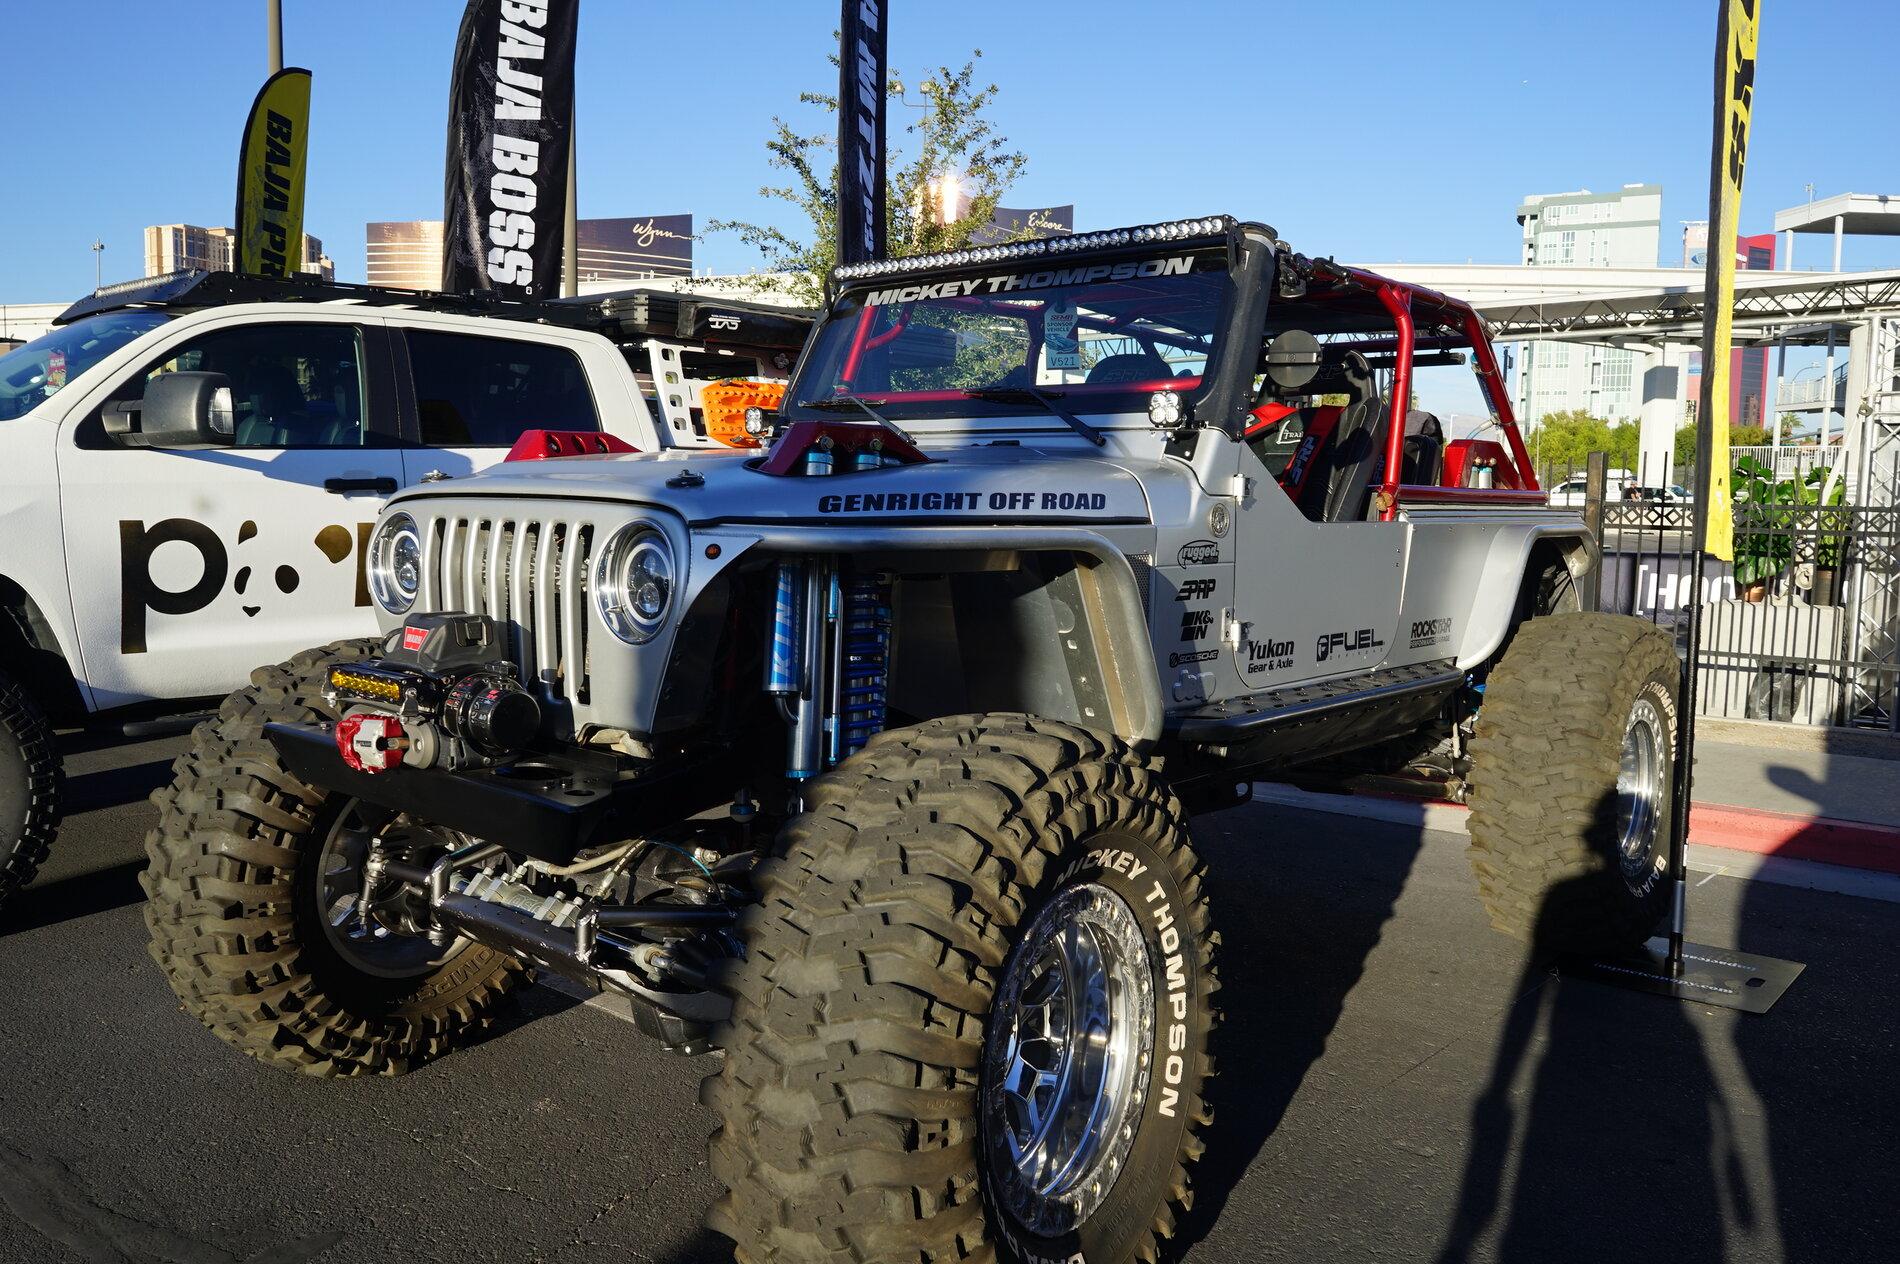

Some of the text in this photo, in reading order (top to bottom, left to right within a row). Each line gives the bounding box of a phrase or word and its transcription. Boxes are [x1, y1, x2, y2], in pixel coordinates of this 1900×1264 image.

[487, 0, 548, 286] BAJA BOSS
[260, 108, 293, 278] BAJA PR
[632, 218, 692, 247] Wynn
[863, 255, 1195, 307] MICKEY THOMPSON
[1050, 356, 1076, 367] V521
[817, 491, 1107, 513] GENRIGHT OFF ROAD
[1329, 628, 1384, 653] FUEL
[1410, 617, 1452, 639] ROCKSTAR
[1249, 639, 1294, 660] Yukon
[1248, 658, 1294, 674] Gear & Axle
[1053, 848, 1187, 1118] MICKEY THOMPSON
